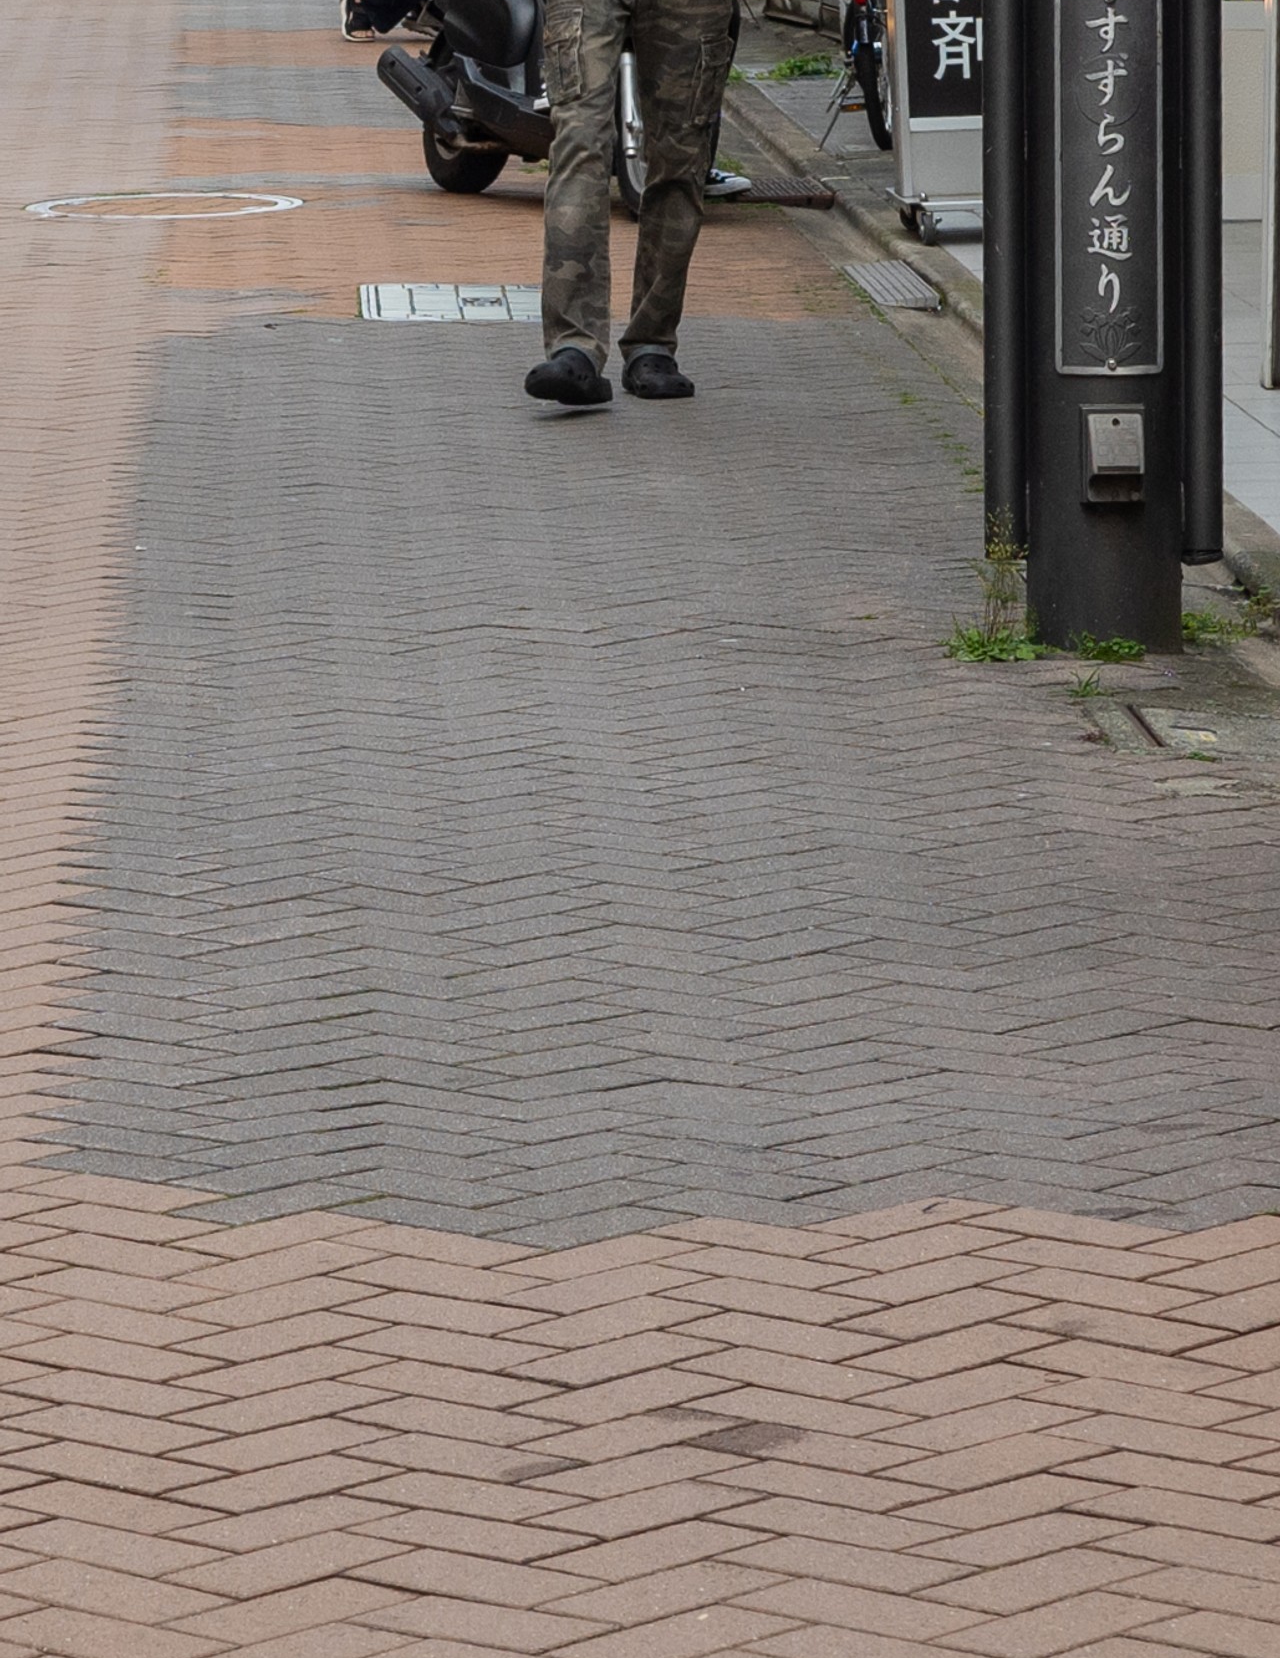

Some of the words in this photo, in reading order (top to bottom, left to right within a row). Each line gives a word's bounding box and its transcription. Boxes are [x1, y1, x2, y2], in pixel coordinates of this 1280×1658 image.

[1085, 6, 1133, 313] すずらん通り
